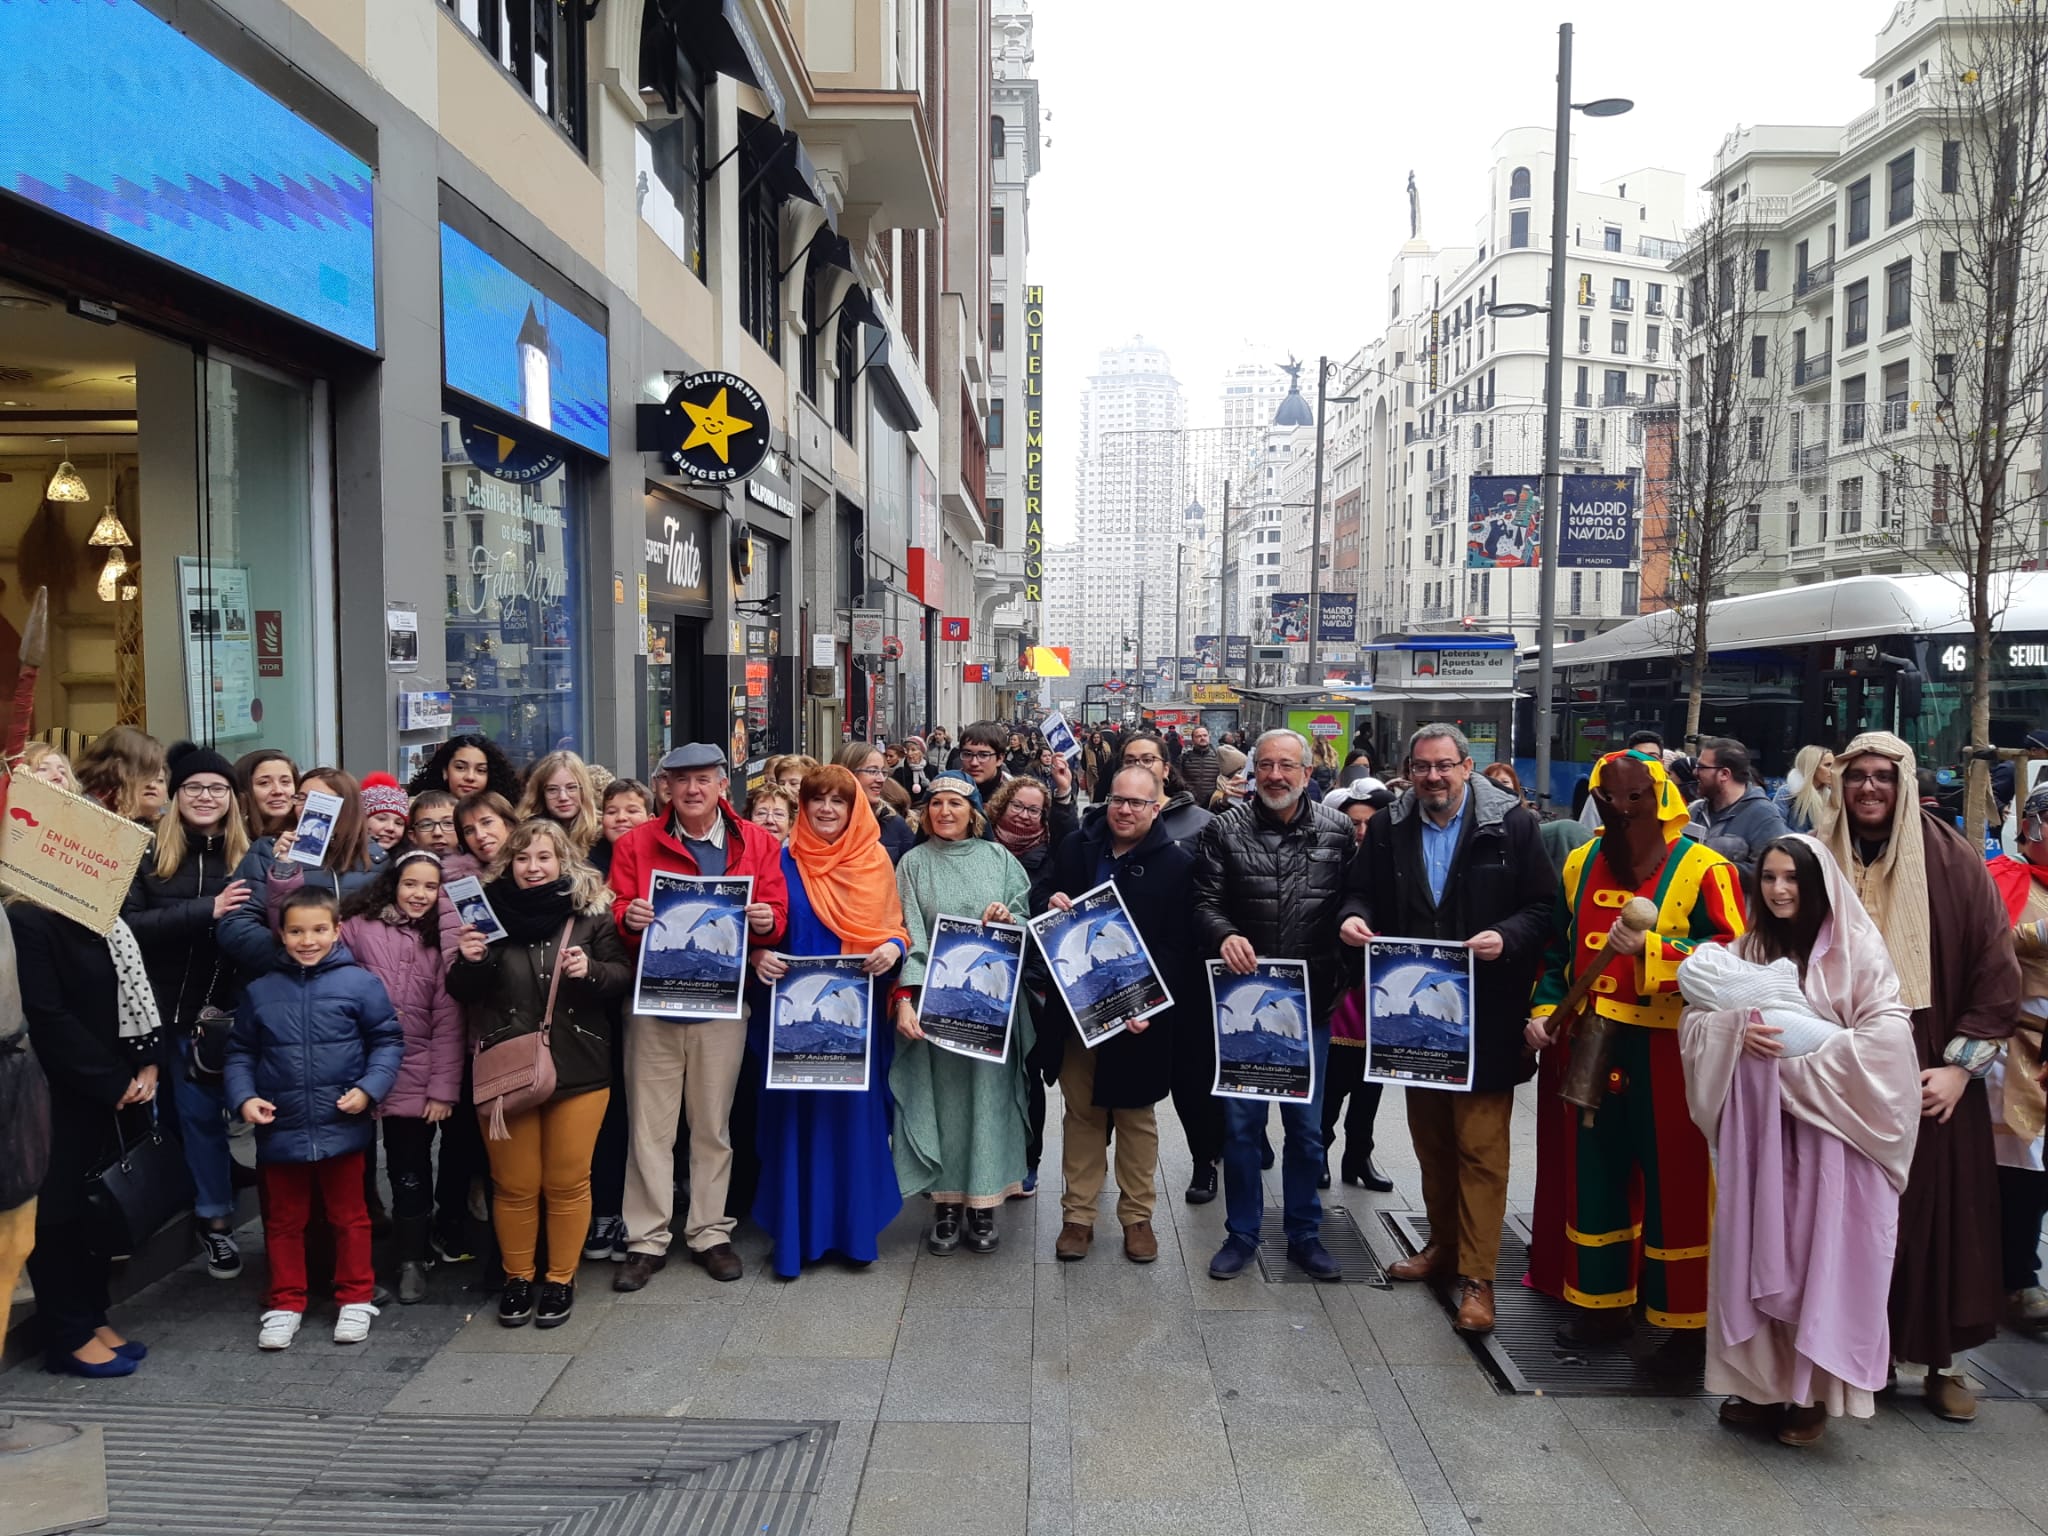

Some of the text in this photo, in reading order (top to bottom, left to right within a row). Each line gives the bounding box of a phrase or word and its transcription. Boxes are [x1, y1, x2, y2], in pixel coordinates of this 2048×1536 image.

[684, 373, 762, 411] CALIFORNIA
[1026, 285, 1043, 602] HOTEL EMPERADOR
[672, 451, 736, 480] BURGERS
[466, 476, 559, 528] Castilla-La Mancha
[1569, 501, 1627, 516] MADRID
[1568, 516, 1627, 526] suena a
[501, 524, 532, 545] os desea
[1567, 527, 1626, 540] NAVIDAD
[664, 515, 702, 590] Taste
[1584, 557, 1613, 565] MADRID
[465, 544, 561, 621] Feliz 2020
[1322, 606, 1354, 615] MADRID
[1483, 650, 1489, 659] y
[1941, 645, 1967, 672] 46
[1441, 659, 1486, 668] Apuestas
[1441, 668, 1474, 676] Estado
[46, 829, 119, 871] EN UN LUGAR
[40, 843, 100, 880] DE TU VIDA
[677, 979, 720, 989] Aniversario
[806, 1053, 848, 1061] Aniversario
[1406, 1047, 1448, 1058] Aniversario
